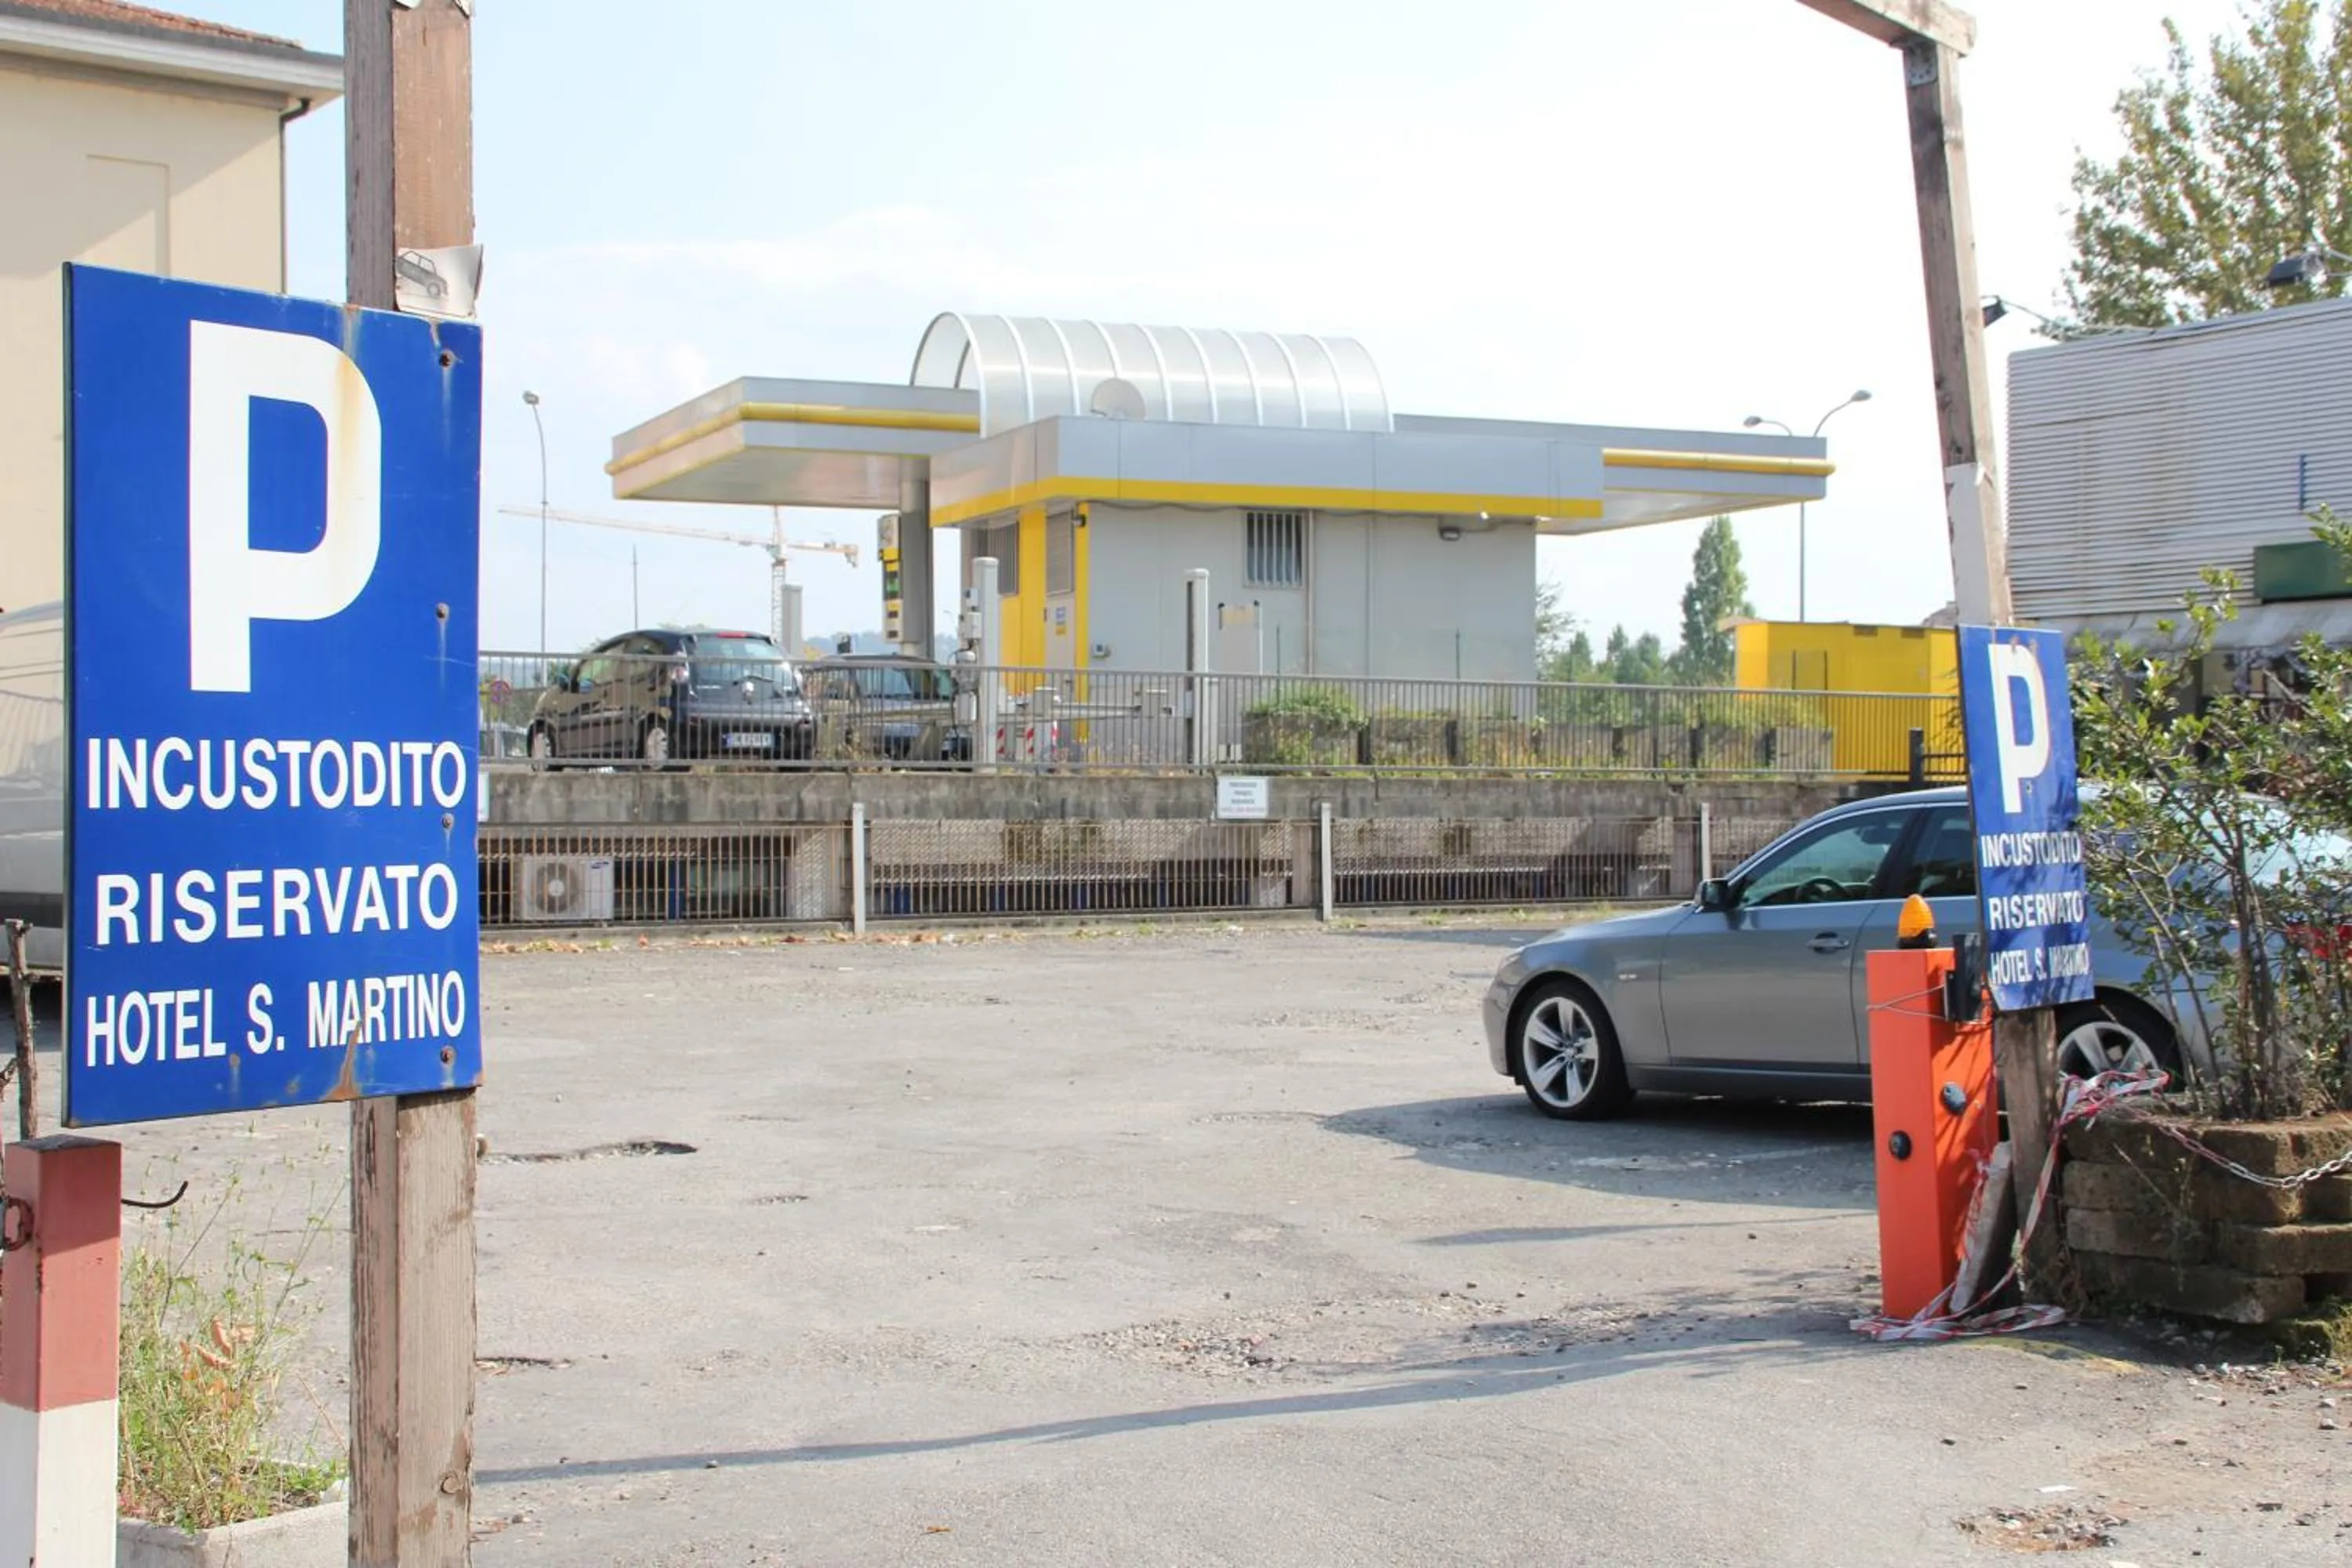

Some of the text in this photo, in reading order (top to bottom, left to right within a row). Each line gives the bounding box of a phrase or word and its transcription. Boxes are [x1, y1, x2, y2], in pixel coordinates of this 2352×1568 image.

[190, 320, 381, 692] P
[1987, 644, 2050, 813] P
[87, 737, 466, 810] INCUSTODITO
[1981, 832, 2082, 868] INCUSTODITO
[96, 862, 459, 945] RISERVATO
[1988, 891, 2084, 931] RISERVATO
[1990, 949, 2032, 985] HOTEL
[2034, 948, 2047, 982] S.
[87, 970, 466, 1067] HOTEL S. MARTINO
